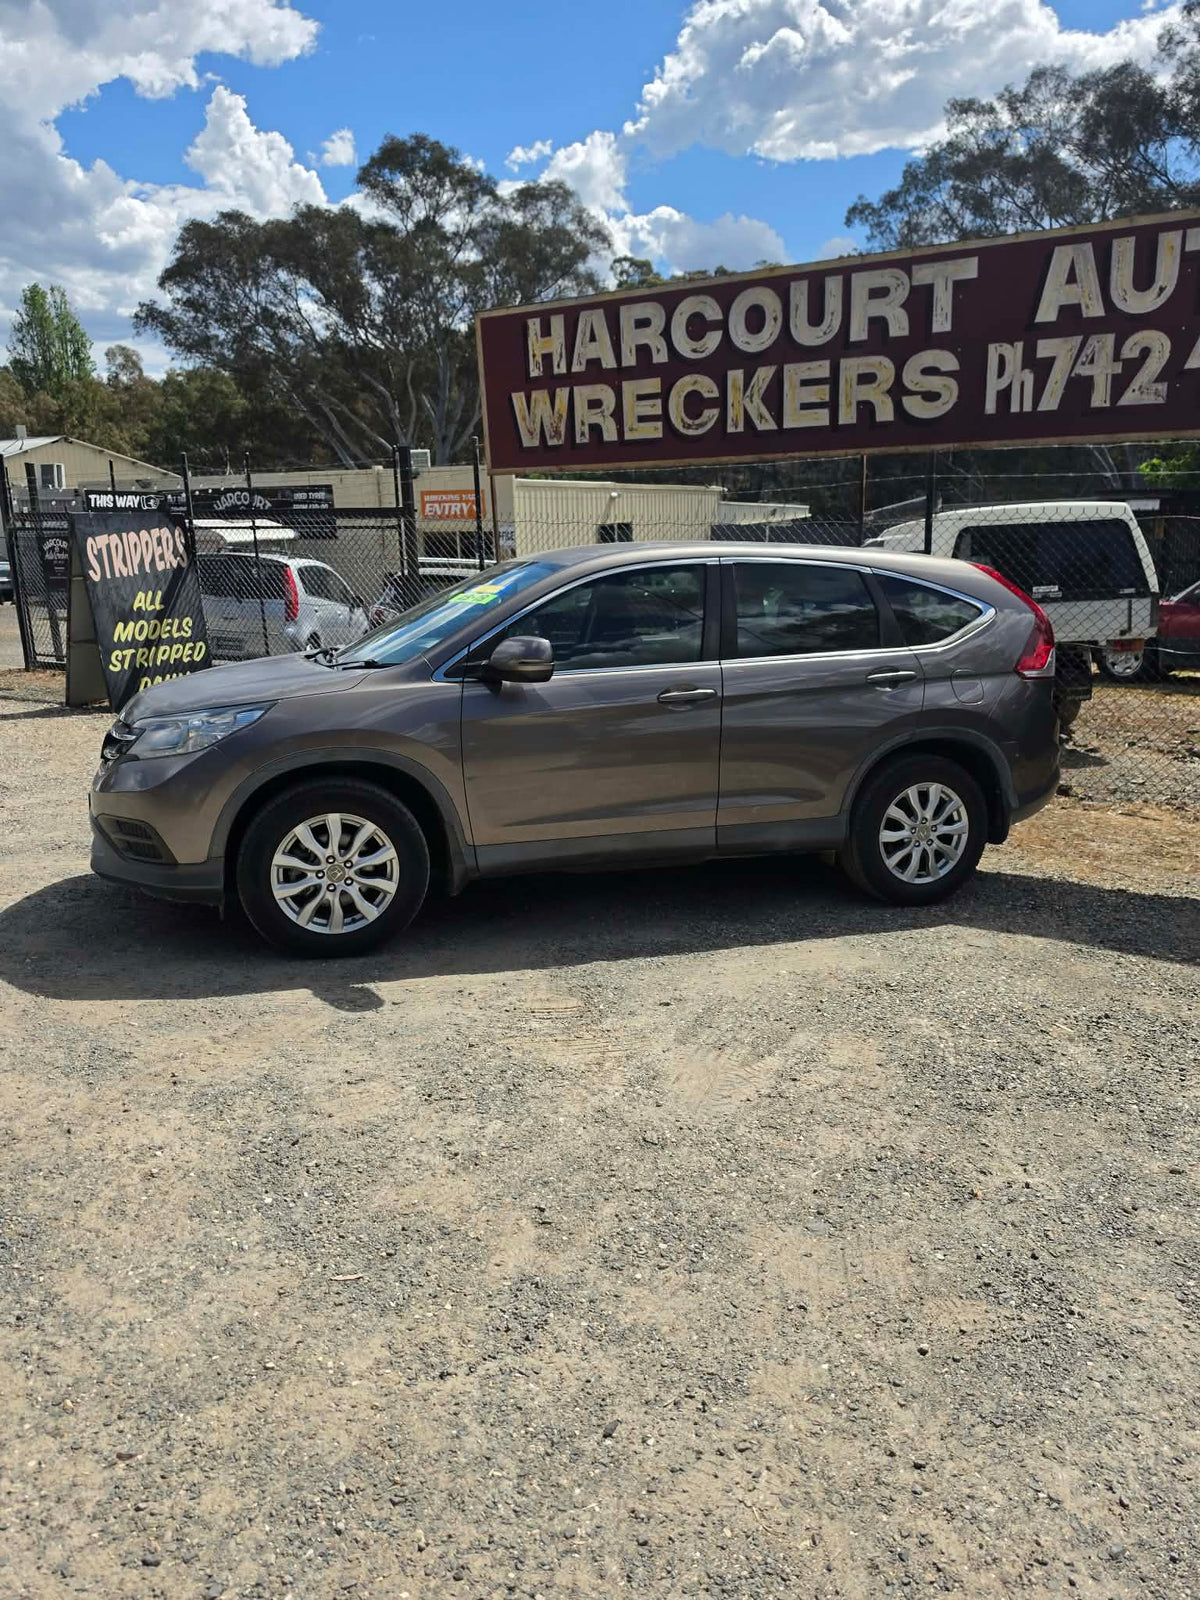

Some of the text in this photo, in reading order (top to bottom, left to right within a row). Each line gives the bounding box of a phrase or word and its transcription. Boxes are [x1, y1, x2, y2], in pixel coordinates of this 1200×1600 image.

[527, 227, 1200, 377] HARCOURT AU
[511, 349, 960, 447] WRECKERS
[88, 494, 140, 508] THIS WAY
[424, 502, 472, 515] ENTRY
[86, 526, 188, 582] STRIPPERS
[133, 590, 164, 611] ALL
[113, 617, 193, 643] MODELS
[109, 642, 206, 672] STRIPPED
